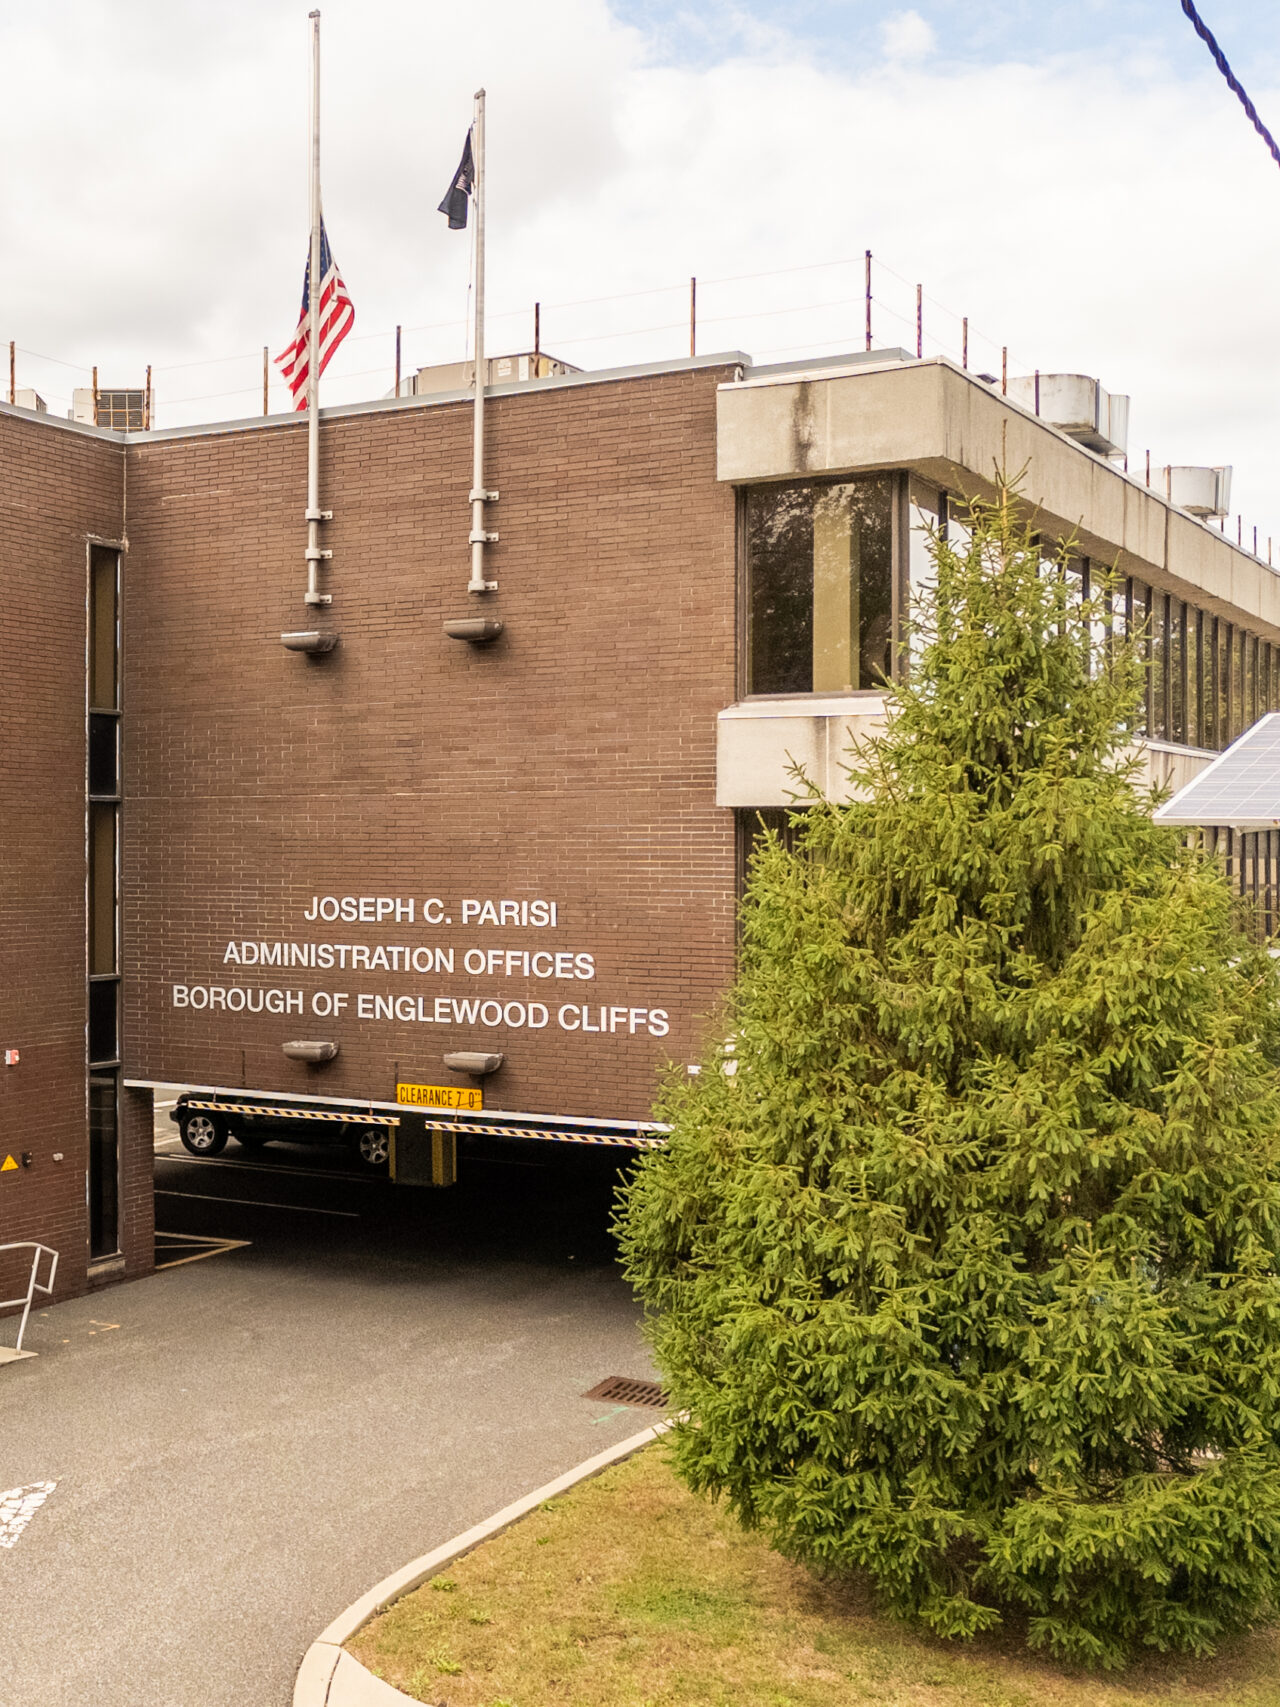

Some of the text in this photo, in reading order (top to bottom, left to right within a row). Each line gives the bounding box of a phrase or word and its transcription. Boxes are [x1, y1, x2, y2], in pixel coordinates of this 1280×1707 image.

[303, 896, 558, 928] JOSEPH C. PARISI
[222, 941, 596, 980] ADMINISTRATION OFFICES
[172, 984, 671, 1037] BOROUGH OF ENGLEWOOD CLIFFS
[400, 1086, 453, 1107] CLEARANCE
